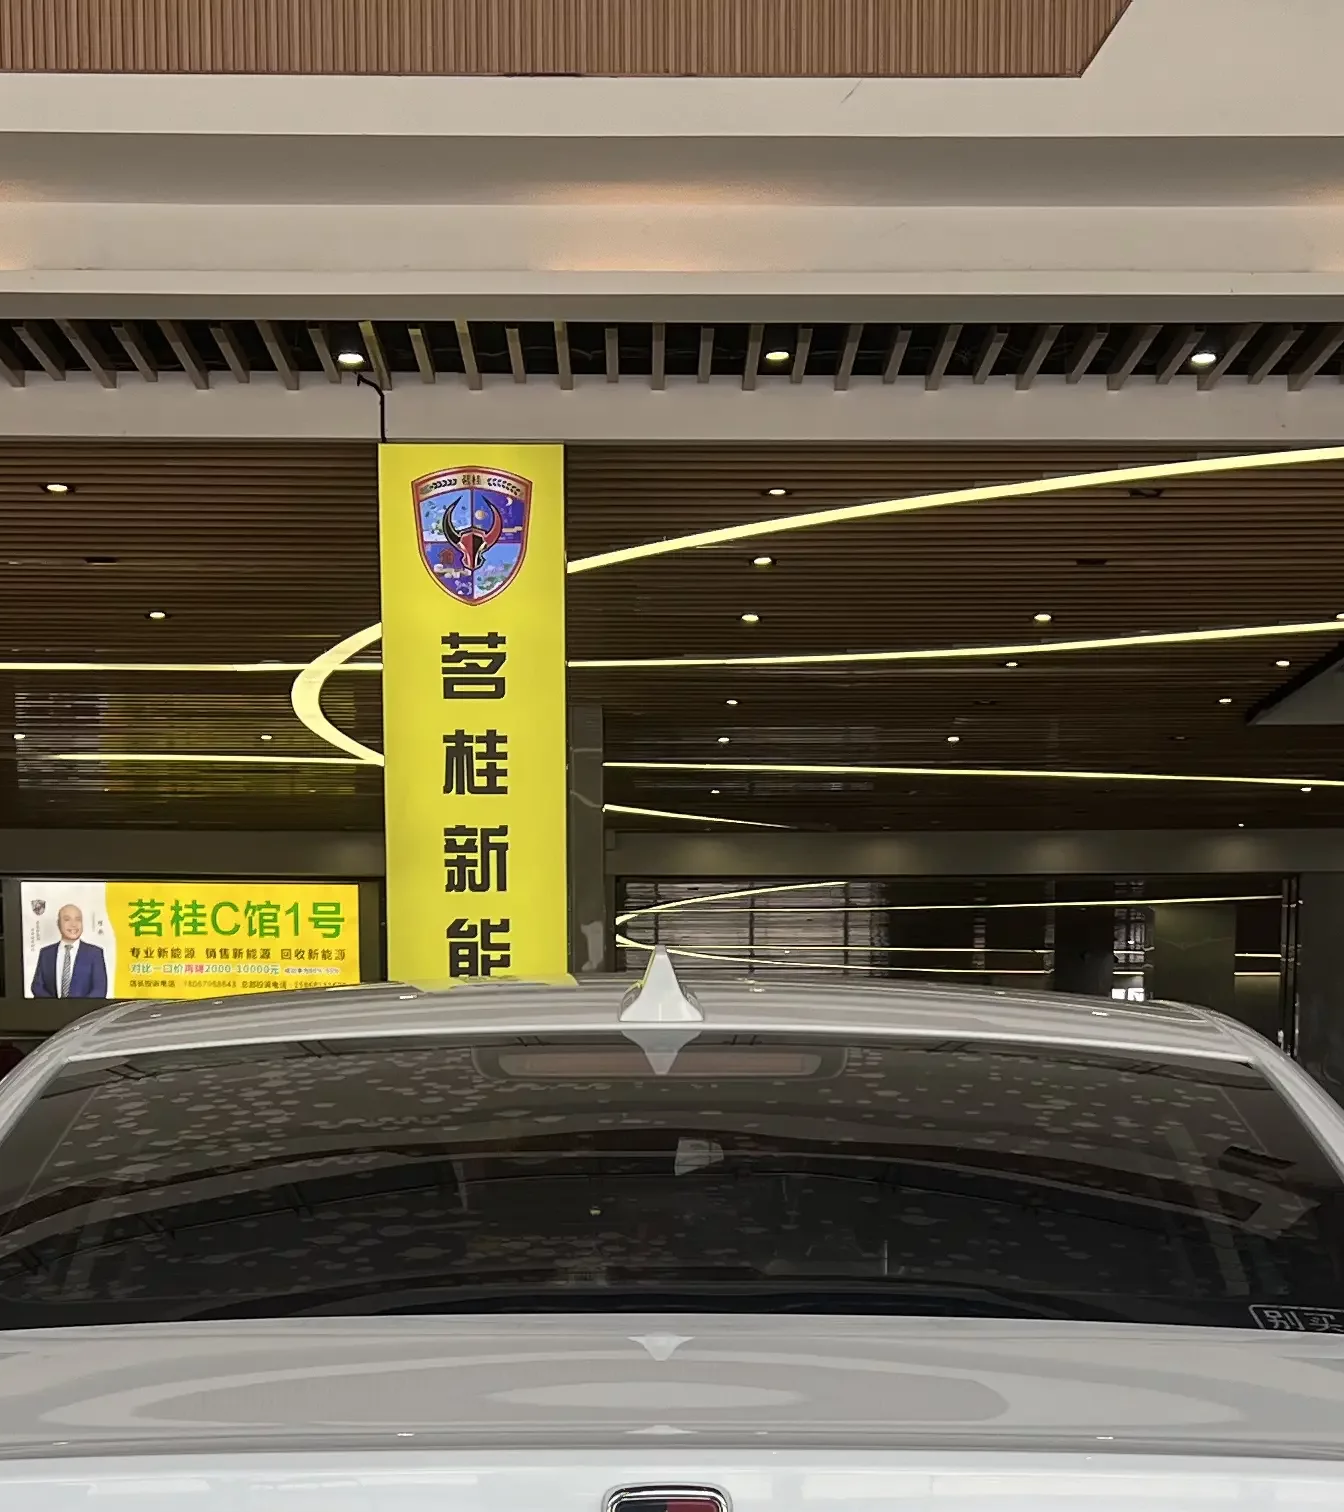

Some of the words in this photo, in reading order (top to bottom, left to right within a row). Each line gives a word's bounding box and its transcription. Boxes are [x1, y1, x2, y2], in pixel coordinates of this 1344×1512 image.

[441, 632, 511, 977] 茗桂新能
[128, 899, 346, 939] 茗桂C馆1号
[129, 947, 196, 960] 专业新能源
[281, 948, 347, 961] 回收新能源
